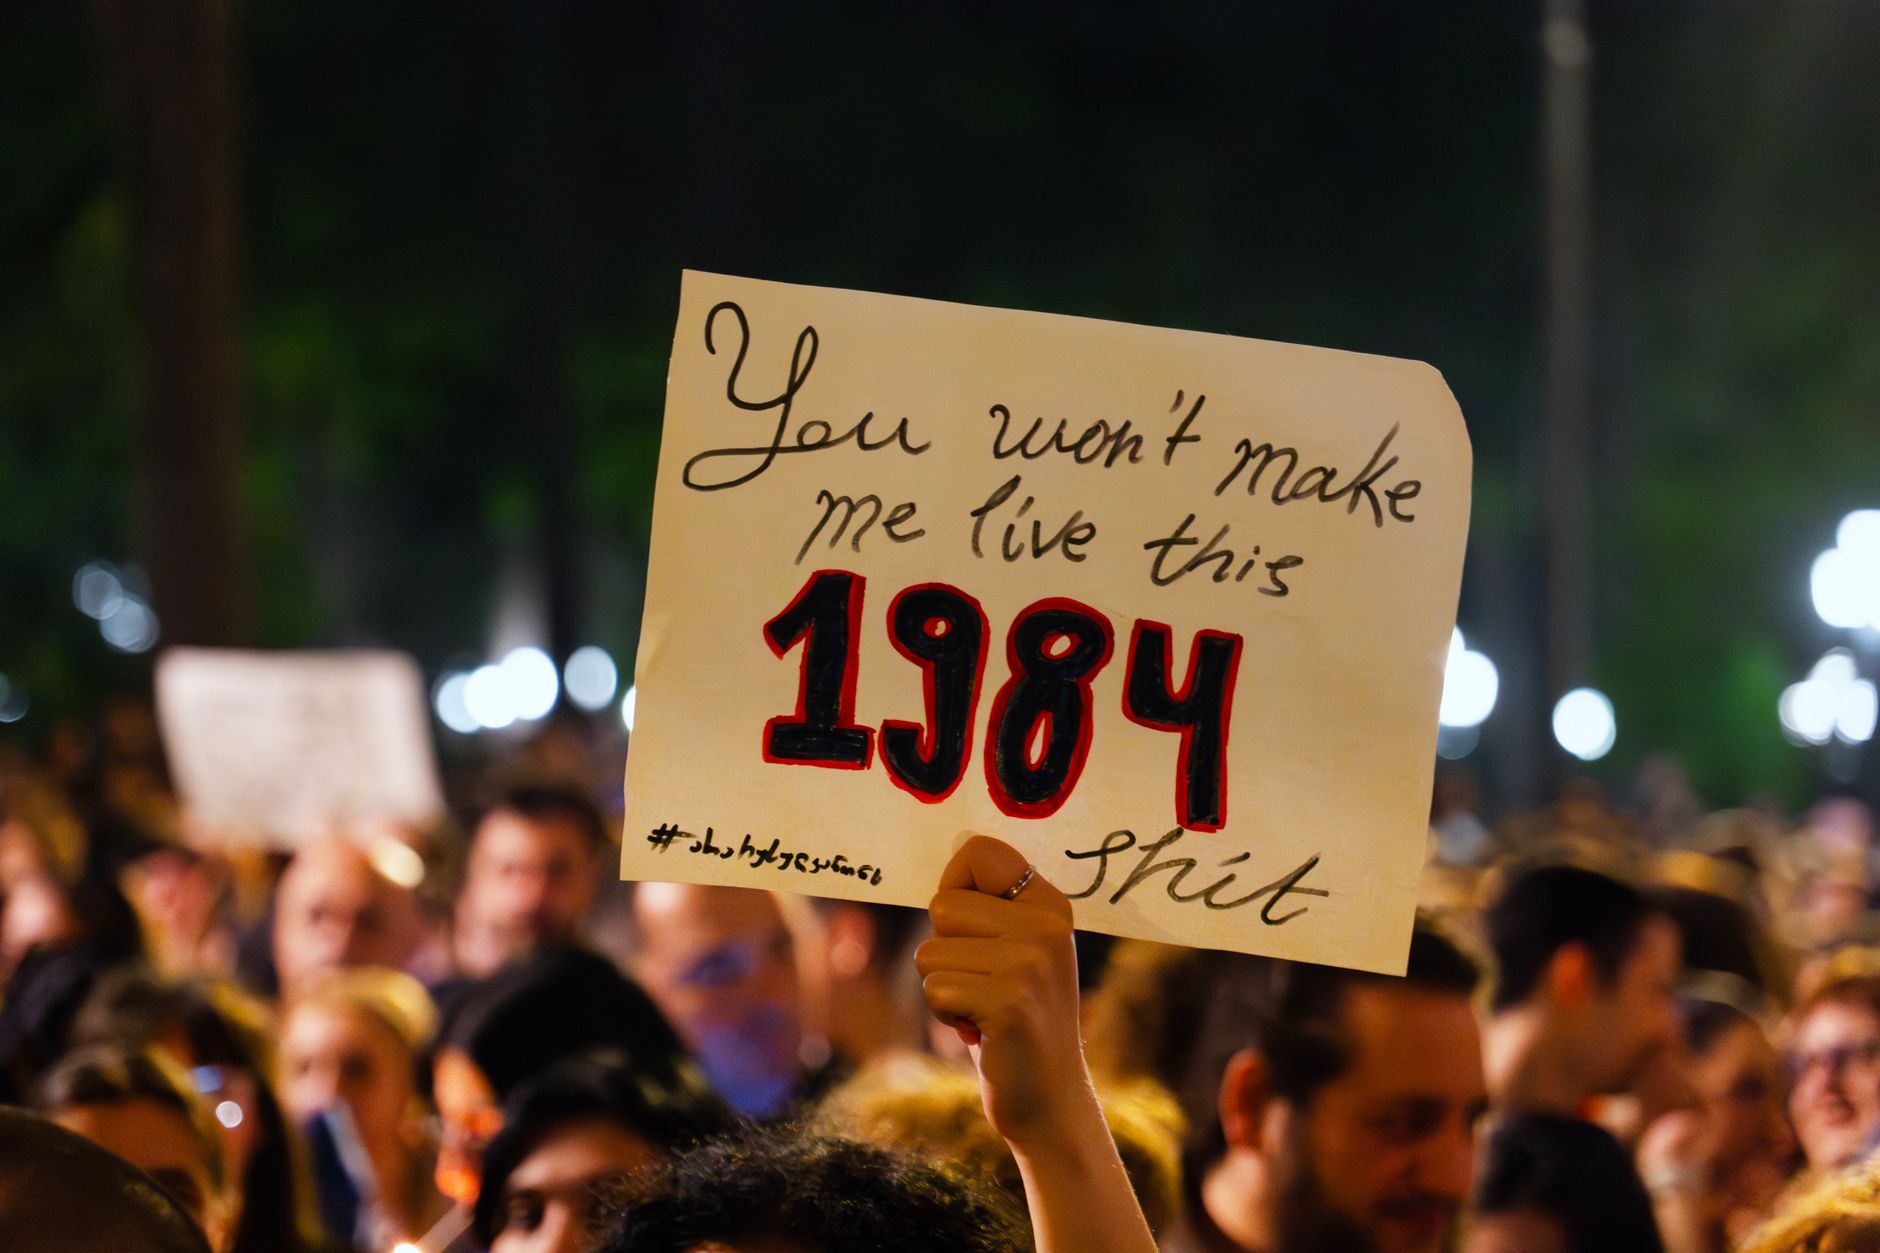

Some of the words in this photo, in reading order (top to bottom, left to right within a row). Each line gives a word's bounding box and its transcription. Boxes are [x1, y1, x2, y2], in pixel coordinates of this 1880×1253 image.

[683, 300, 932, 491] You
[989, 389, 1206, 468] won't
[1215, 421, 1422, 528] make
[795, 489, 926, 565] me
[970, 474, 1096, 563] live
[1144, 513, 1303, 597] this
[763, 568, 1244, 833] 1984
